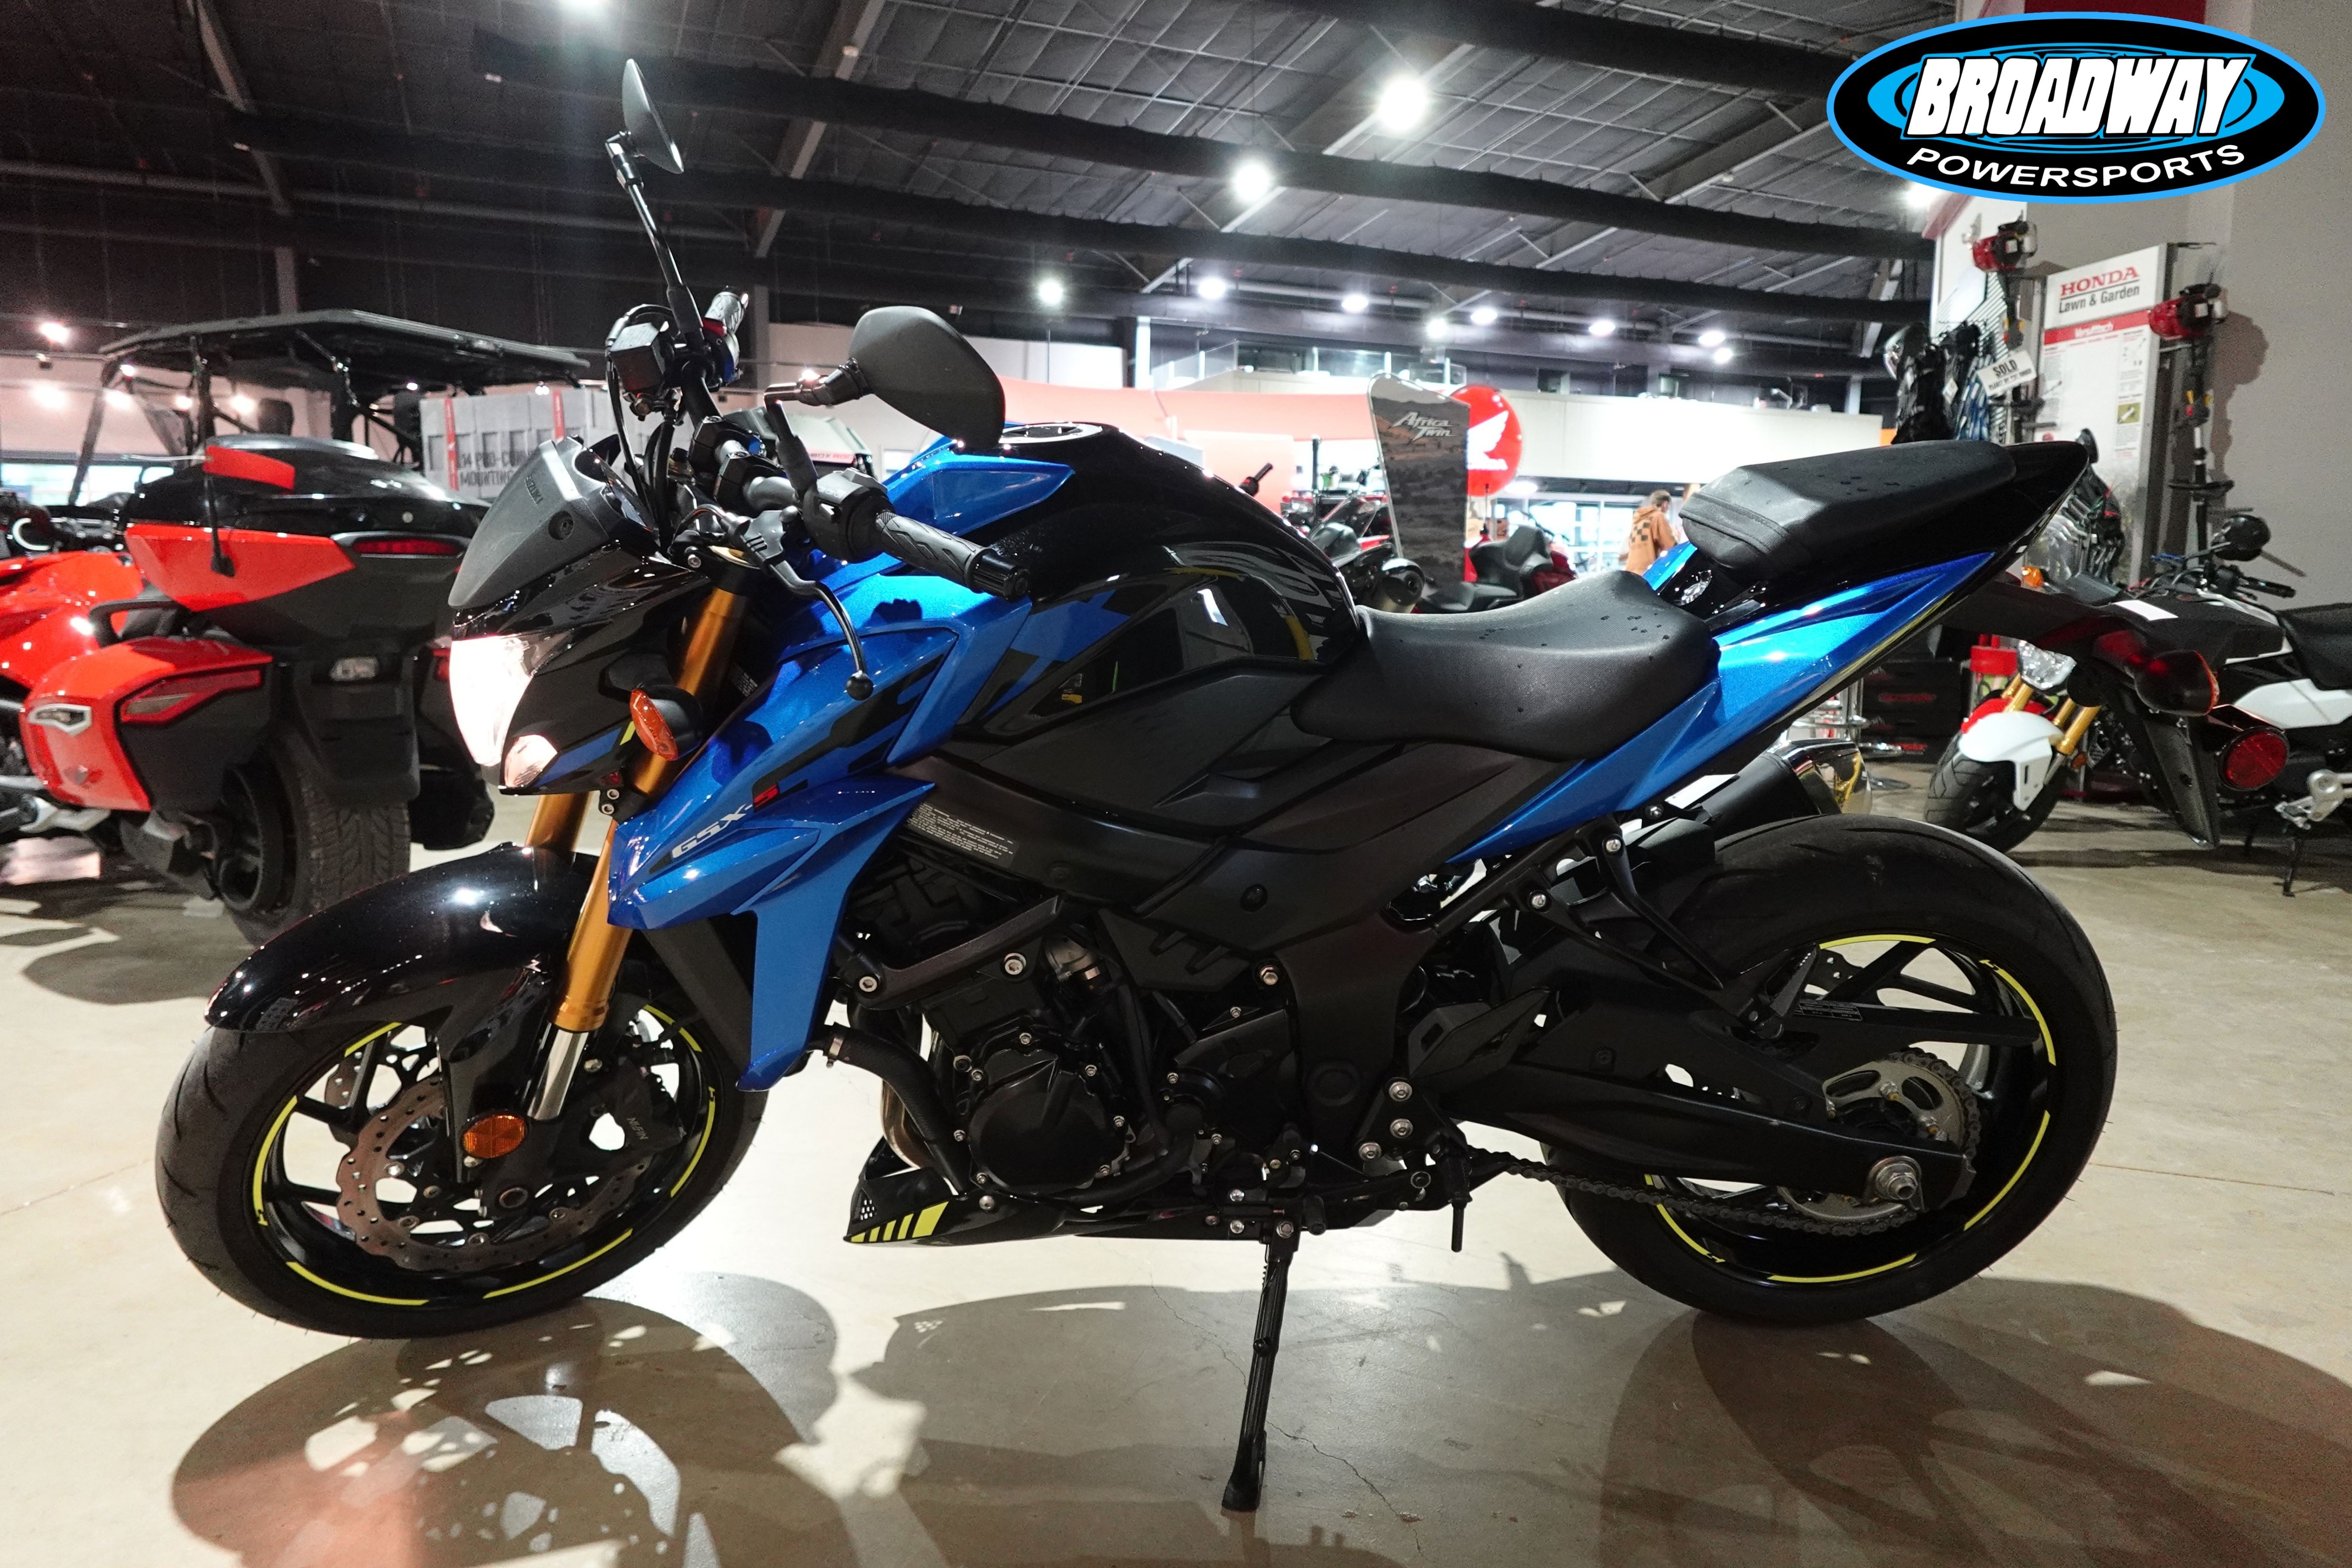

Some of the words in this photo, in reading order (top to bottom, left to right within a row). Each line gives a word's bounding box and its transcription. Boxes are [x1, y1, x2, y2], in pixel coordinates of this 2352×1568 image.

[2060, 266, 2139, 297] HONDA
[2058, 299, 2086, 313] Lawn
[2089, 294, 2097, 306] &
[2100, 286, 2140, 303] Garden
[1993, 359, 2018, 377] SOLD
[1391, 411, 1455, 428] Africa
[1412, 426, 1458, 442] Twin
[524, 474, 544, 505] SUZUKI
